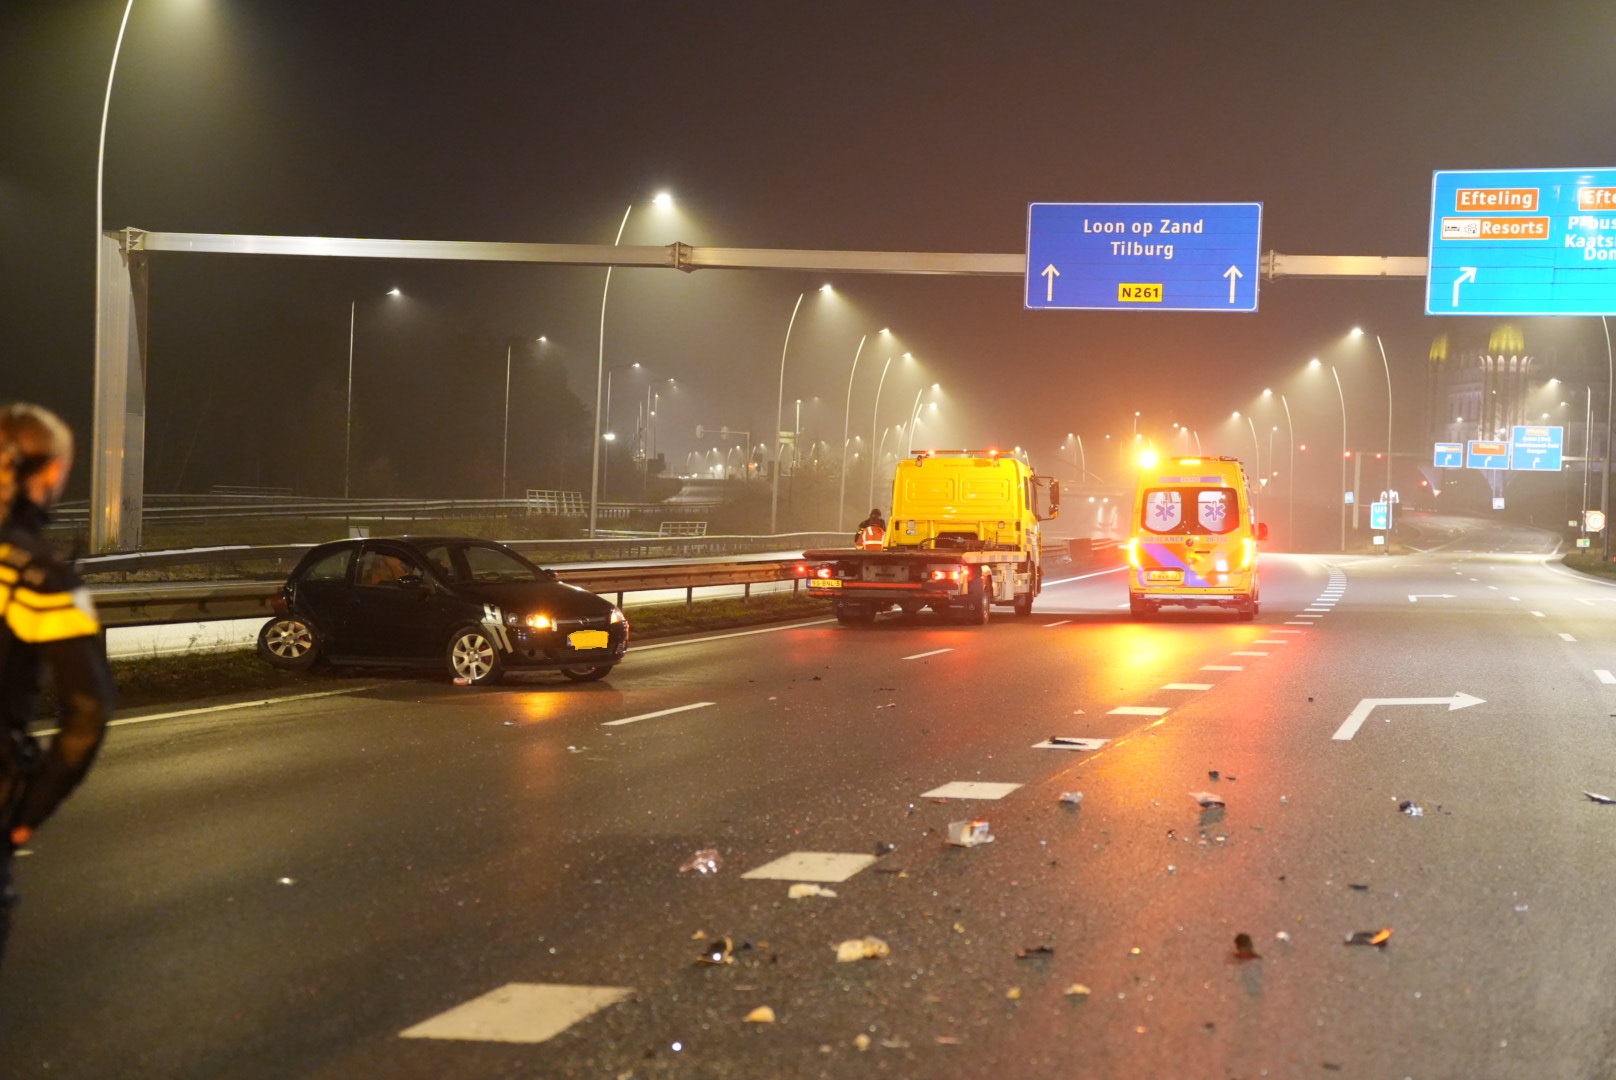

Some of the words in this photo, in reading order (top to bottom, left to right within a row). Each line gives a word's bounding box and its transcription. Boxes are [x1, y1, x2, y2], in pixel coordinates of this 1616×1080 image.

[1461, 190, 1533, 209] Efteling
[1083, 219, 1125, 233] Loon
[1131, 223, 1154, 237] op
[1159, 219, 1204, 234] Zand
[1481, 221, 1544, 235] Resorts
[1564, 233, 1616, 248] Kaats
[1110, 241, 1175, 260] Tilburg
[1121, 287, 1160, 299] N261
